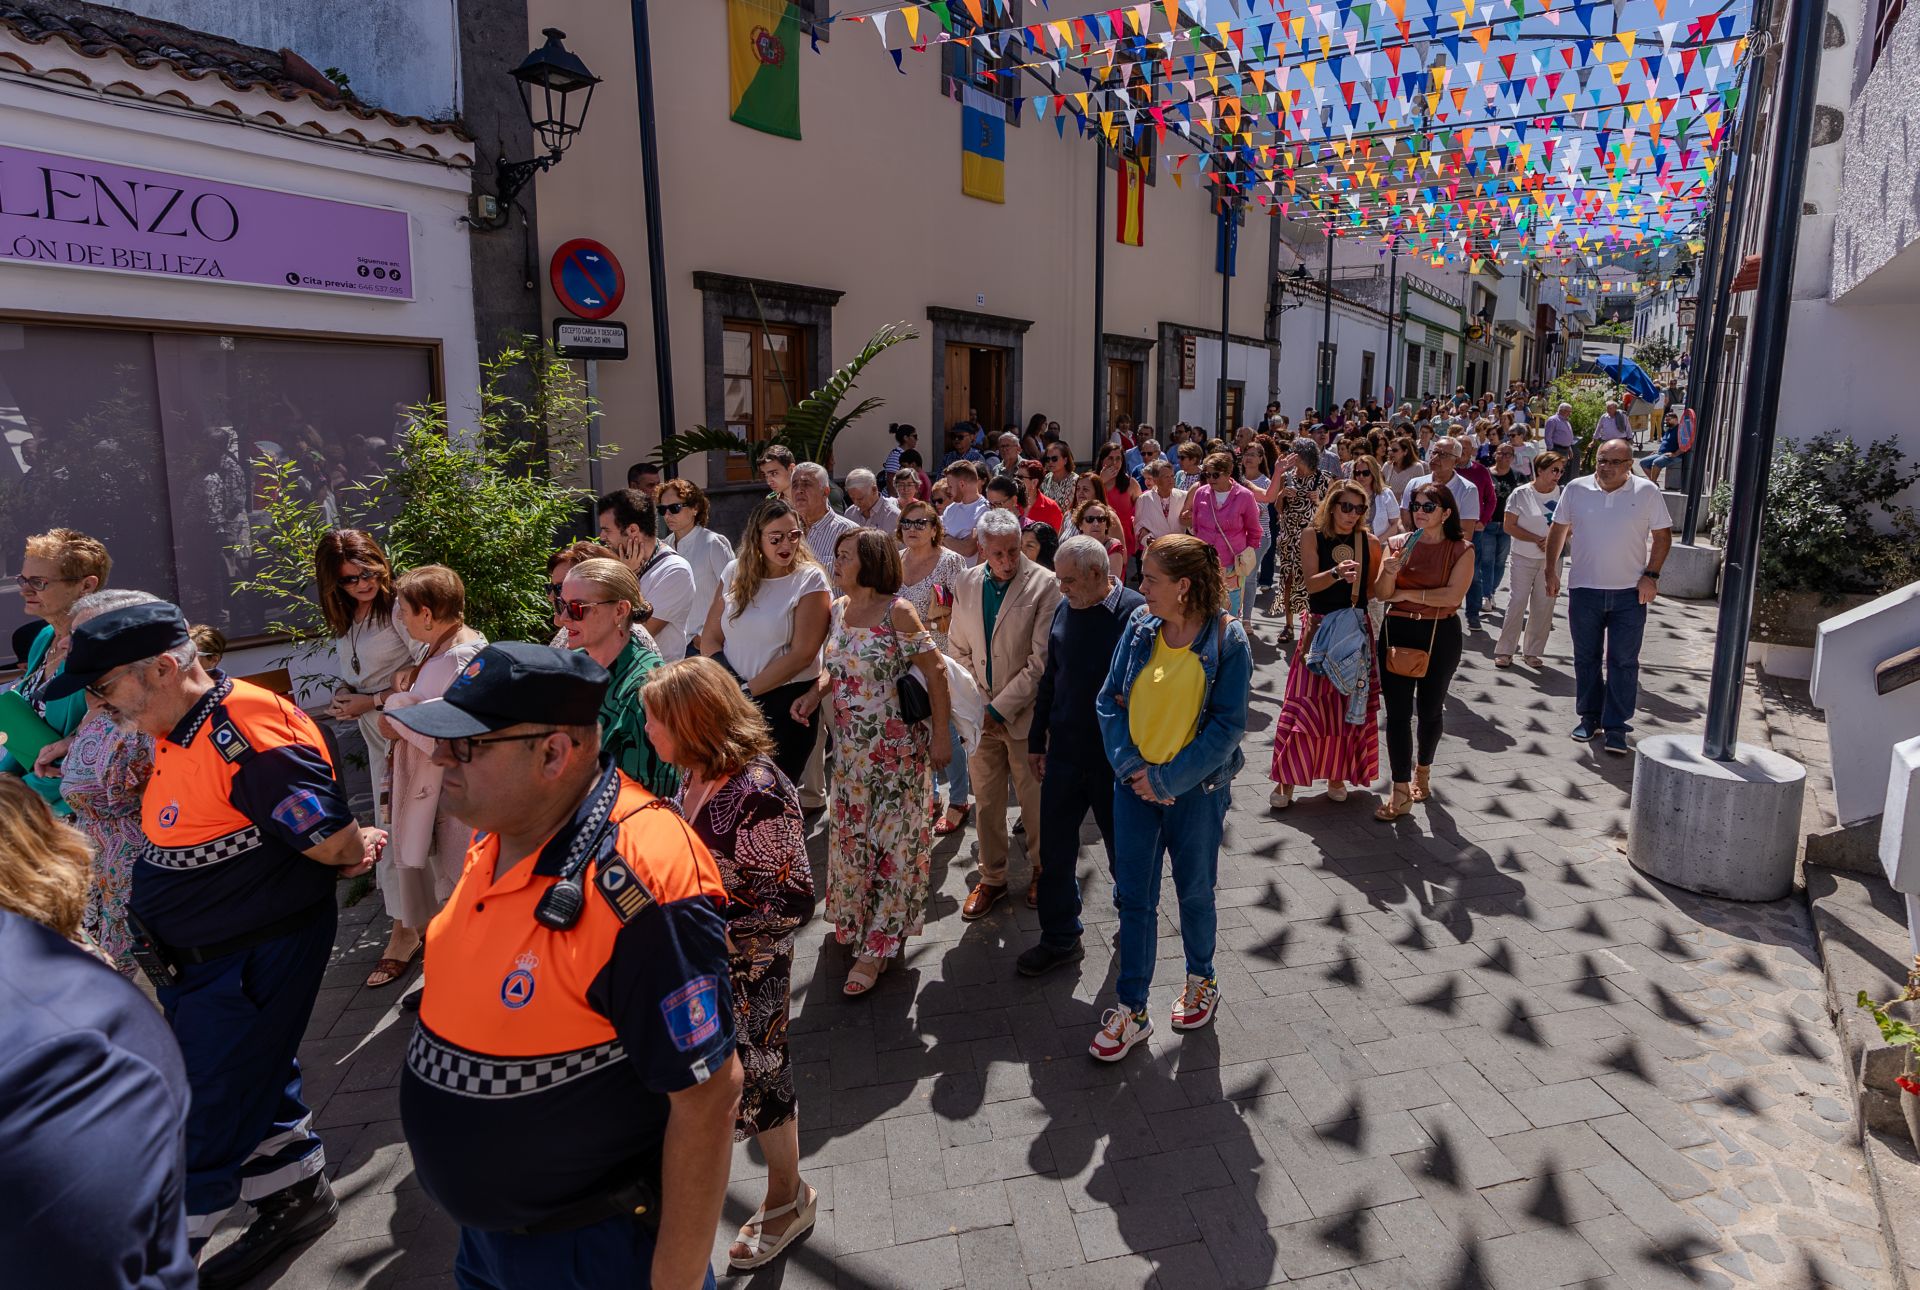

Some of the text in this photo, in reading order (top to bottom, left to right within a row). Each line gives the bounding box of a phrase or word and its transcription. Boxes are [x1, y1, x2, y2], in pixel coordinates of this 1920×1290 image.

[65, 242, 105, 265] DE
[110, 247, 225, 278] BELLEZA
[302, 276, 403, 295] Cita previa: 646 537 595
[562, 326, 581, 334] EXCEPTO
